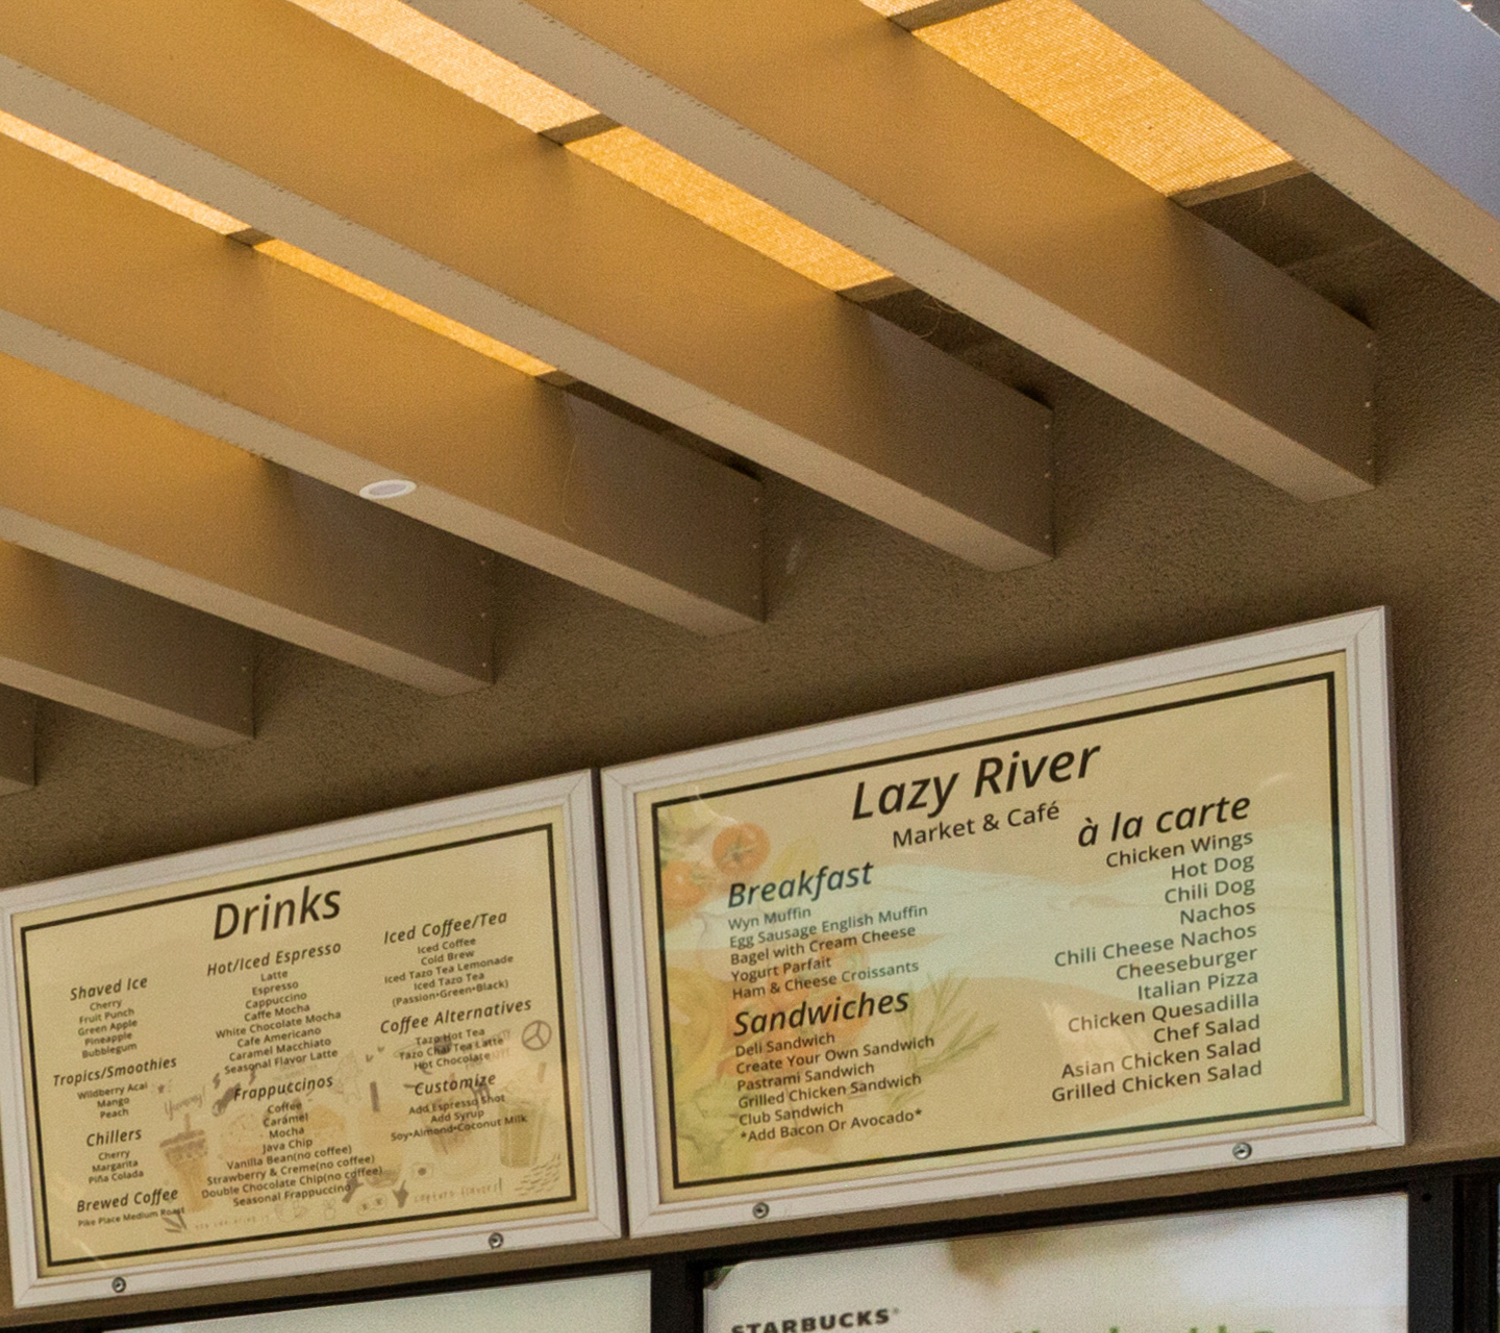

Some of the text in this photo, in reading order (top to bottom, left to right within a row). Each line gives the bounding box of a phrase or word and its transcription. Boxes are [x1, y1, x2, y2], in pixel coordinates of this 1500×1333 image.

[852, 745, 1101, 821] Lazy River
[893, 800, 1060, 848] Market & Café
[1078, 796, 1251, 847] à la carte
[1105, 832, 1253, 868] Chicken Wings
[1171, 855, 1255, 880] Hot Dog
[728, 861, 874, 909] Breakfast
[1164, 878, 1256, 904] Chili Dog
[213, 885, 341, 940] Drinks
[727, 907, 812, 932] Wyn Muffin
[1180, 902, 1256, 925] Nachos
[383, 912, 507, 944] Iced Coffee/Tea
[729, 905, 928, 950] Egg Sausage English Muffin
[417, 938, 477, 954] Iced Coffee
[420, 950, 475, 966] Cold Brew
[730, 927, 916, 966] Bagel with Cream Cheese
[1054, 925, 1257, 967] Chili Cheese Nachos
[206, 942, 342, 977] Hot/Iced Espresso
[730, 956, 831, 983] Yogurt Parfait
[1116, 948, 1258, 981] Cheeseburger
[251, 981, 299, 996] Espresso
[260, 970, 288, 982] Latte
[732, 962, 919, 1000] Ham & Cheese Croissants
[1138, 971, 1258, 1000] Italian Pizza
[70, 977, 148, 1001] Shaved Ice
[245, 992, 308, 1010] Cappuccino
[78, 1007, 135, 1024] Fruit Punch
[89, 1000, 122, 1012] Cherry
[274, 1004, 311, 1016] Mocha
[380, 999, 532, 1035] Coffee Alternatives
[733, 991, 909, 1037] Sandwiches
[1068, 992, 1259, 1033] Chicken Quesadilla
[77, 1019, 138, 1036] Green Apple
[215, 1011, 342, 1039] White Chocolate Mocha
[263, 1027, 322, 1043] Americano
[1153, 1014, 1260, 1044] Chef Salad
[81, 1043, 137, 1059] Bubblegum
[84, 1032, 133, 1046] Pineapple
[229, 1038, 332, 1062] Caramel Macchiato
[735, 1032, 835, 1058] Deli Sandwich
[736, 1035, 935, 1075] Create Your Own Sandwich
[1061, 1037, 1261, 1079] Asian Chicken Salad
[53, 1057, 177, 1087] Tropics/Smoothies
[411, 1073, 496, 1096] Customize
[737, 1061, 875, 1092] Pastrami Sandwich
[1051, 1060, 1262, 1102] Grilled Chicken Salad
[77, 1082, 148, 1100] Wildberry Acai
[231, 1076, 333, 1102] Frappuccinos
[738, 1072, 922, 1109] Grilled Chicken Sandwich
[96, 1097, 130, 1108] Mango
[99, 1108, 129, 1119] Peach
[266, 1101, 303, 1114] Coffee
[738, 1101, 844, 1126] Club Sandwich
[262, 1112, 309, 1128] Caramel
[430, 1110, 485, 1123] Add Syrup
[86, 1129, 142, 1147] Chillers
[268, 1127, 305, 1139] Mocha
[98, 1150, 131, 1161] Cherry
[262, 1138, 314, 1155] Java Chip
[88, 1169, 144, 1184] Piña Colada
[91, 1160, 139, 1173] Margarita
[76, 1188, 179, 1213] Brewed Coffee
